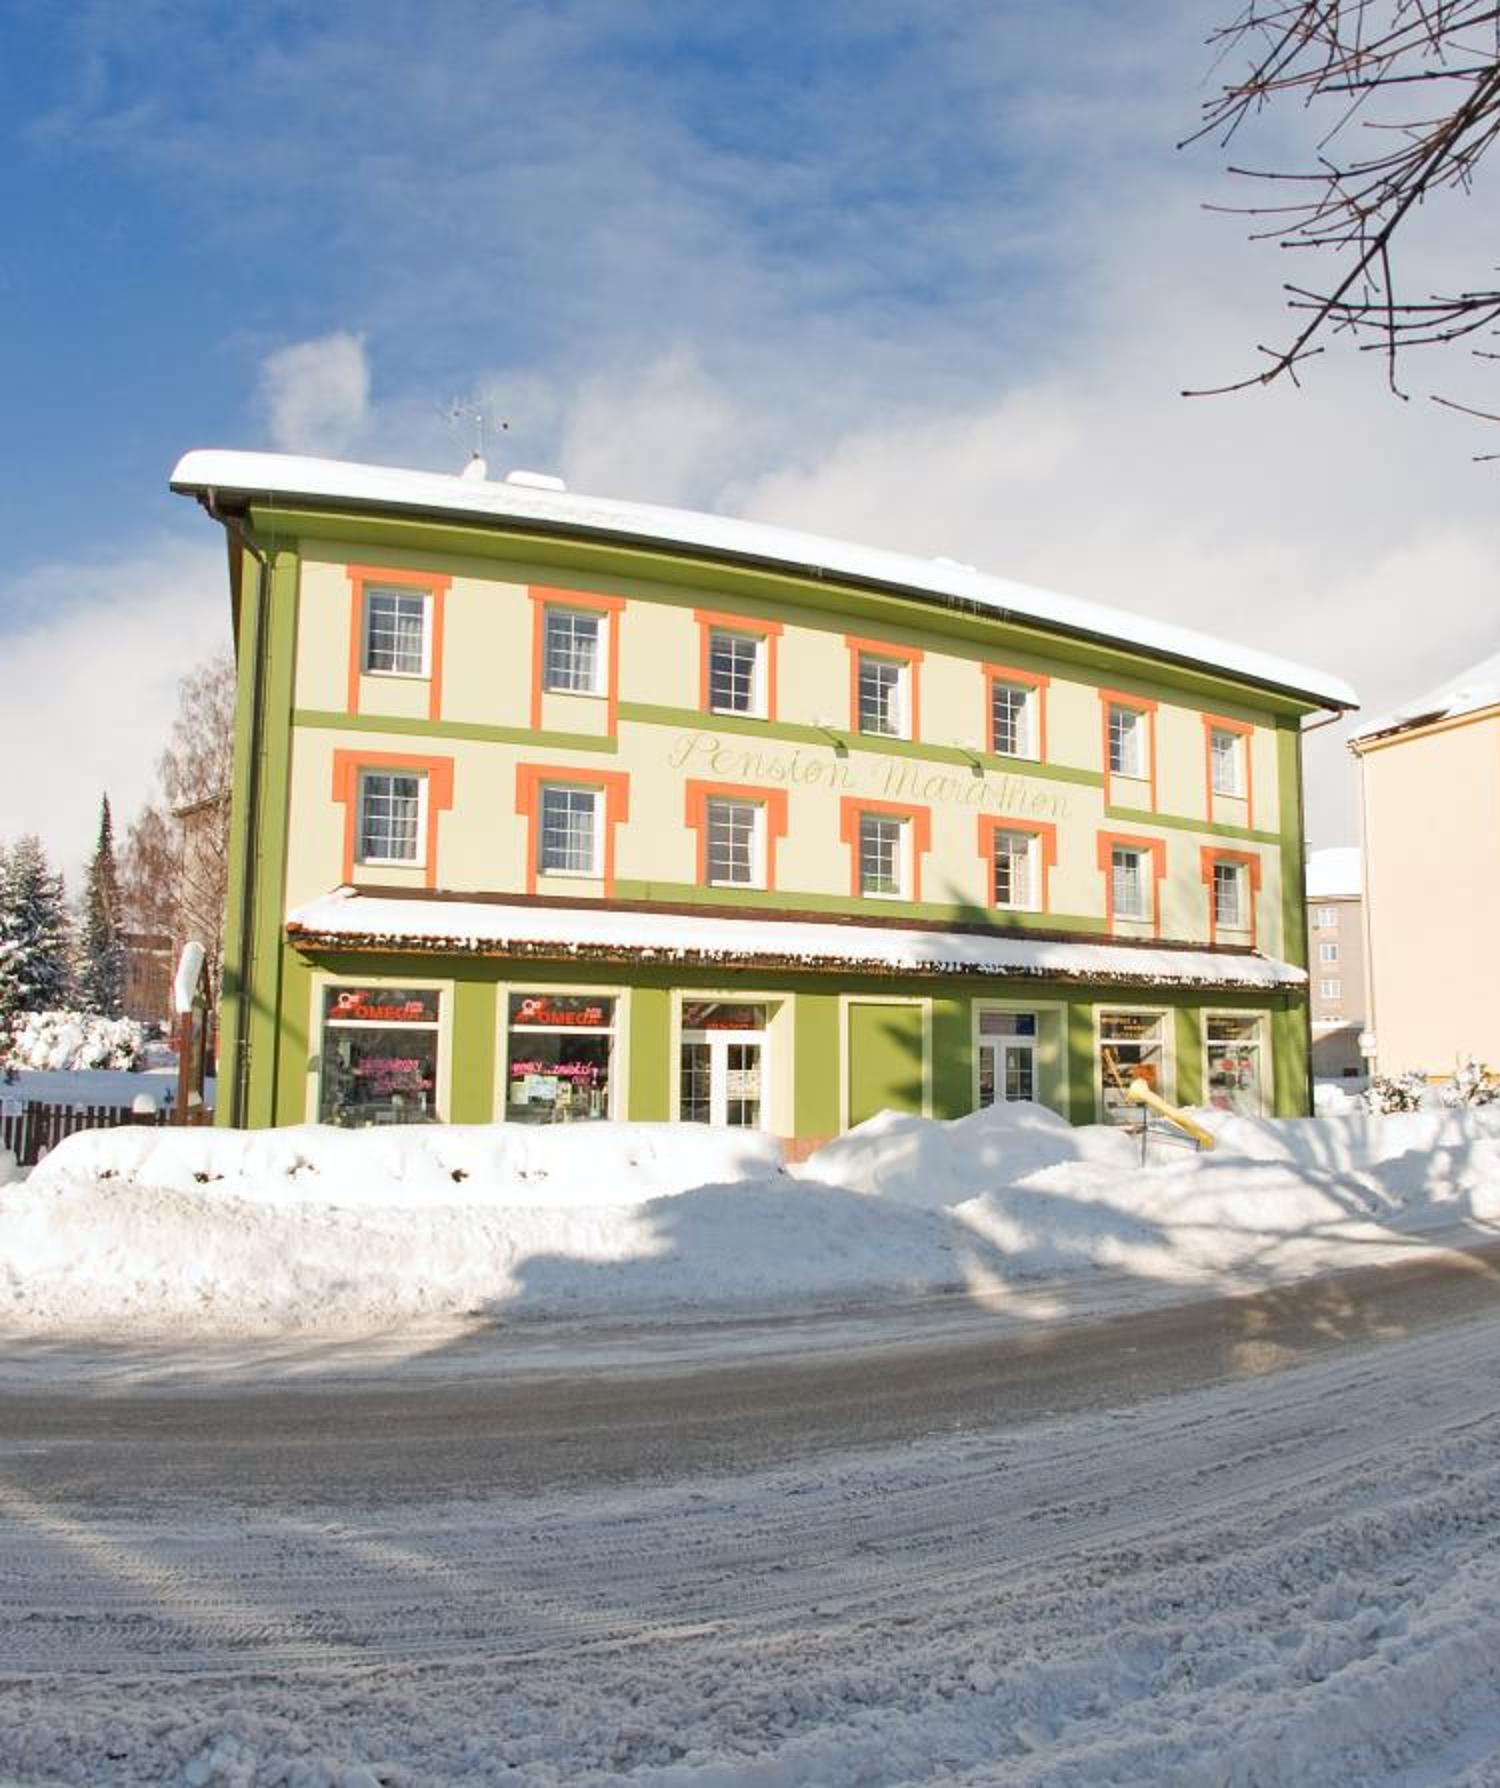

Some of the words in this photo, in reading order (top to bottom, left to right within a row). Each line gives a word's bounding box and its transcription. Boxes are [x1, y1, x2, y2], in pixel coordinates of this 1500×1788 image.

[669, 733, 854, 788] Pension
[878, 763, 1071, 817] Marathon
[355, 1005, 421, 1019] OMEGA
[538, 1010, 602, 1025] OMEGA
